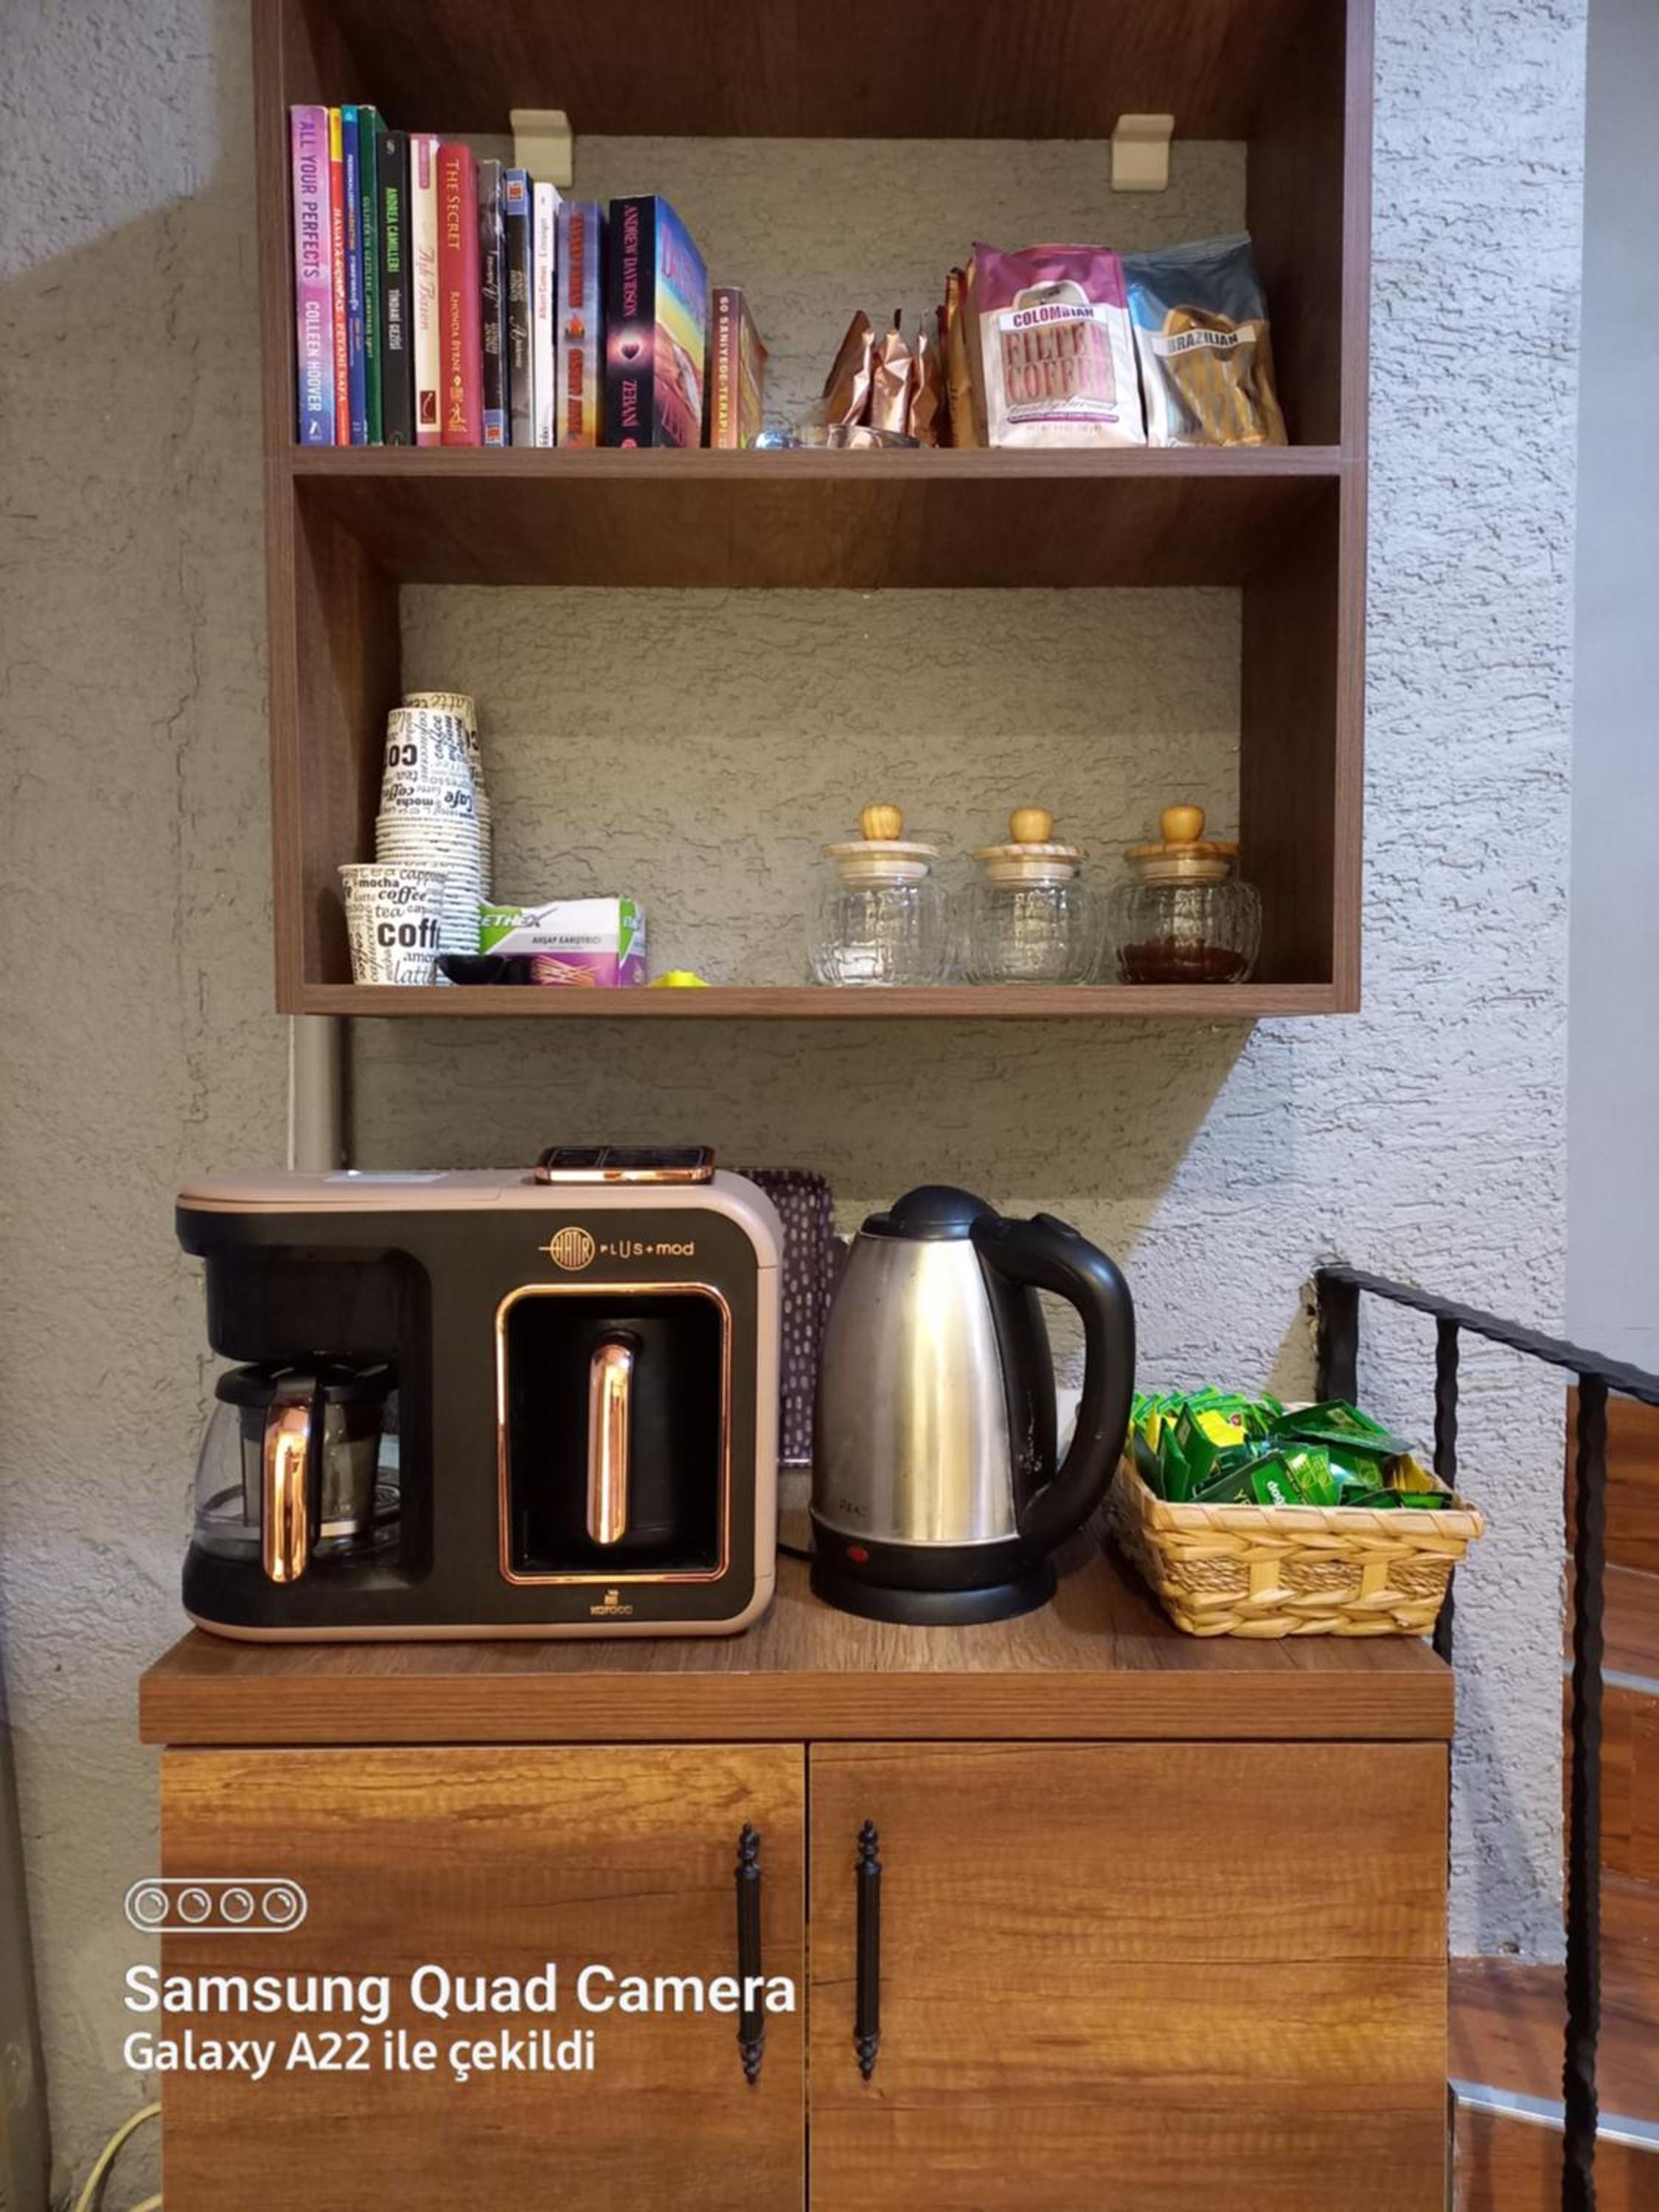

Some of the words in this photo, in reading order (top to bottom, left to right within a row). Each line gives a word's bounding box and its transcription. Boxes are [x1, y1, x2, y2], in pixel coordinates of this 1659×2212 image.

[299, 121, 317, 148] ALL
[301, 155, 319, 195] YOUR
[445, 159, 460, 193] THE
[387, 187, 399, 224] ANDREA
[446, 195, 460, 251] SECRET
[302, 201, 319, 279] PERFECTS
[624, 204, 639, 255] ANDREW
[387, 226, 400, 272] CAMILLERI
[624, 257, 638, 317] DAVIDSON
[305, 301, 321, 355] COLLEEN
[450, 291, 461, 338] RHONDA
[1013, 306, 1094, 327] COLOMBIAN
[451, 340, 462, 372] BYRNE
[1167, 330, 1238, 353] BRAZILIAN
[306, 361, 322, 411] HOOVER
[359, 877, 400, 888] mocha
[378, 886, 428, 905] coffee
[375, 904, 405, 919] tea
